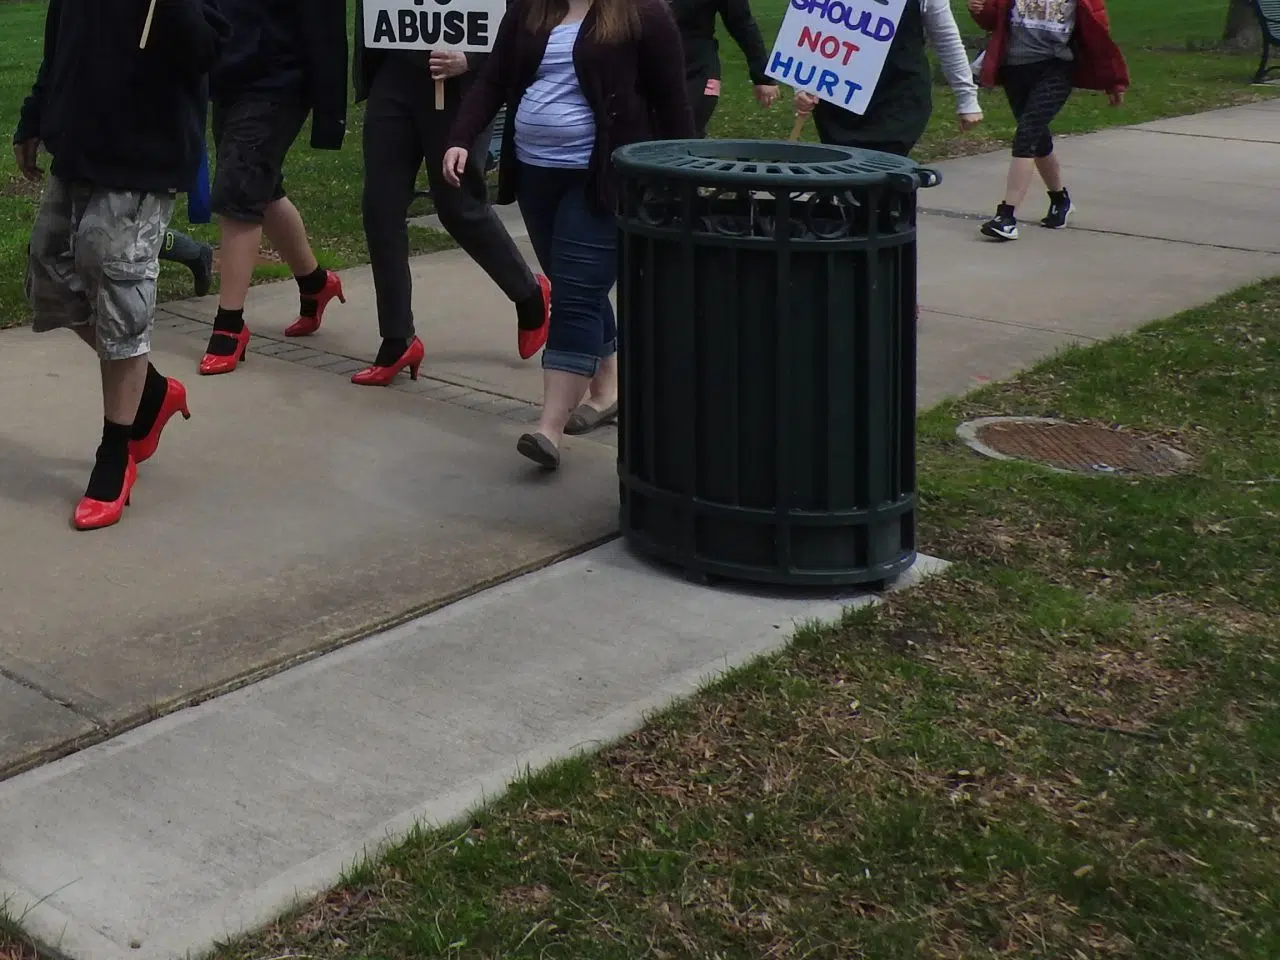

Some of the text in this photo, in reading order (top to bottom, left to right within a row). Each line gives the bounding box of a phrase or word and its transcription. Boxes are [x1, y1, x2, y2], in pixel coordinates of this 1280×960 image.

[373, 9, 489, 46] ABUSE
[797, 26, 860, 66] NOT
[770, 51, 863, 104] HURT
